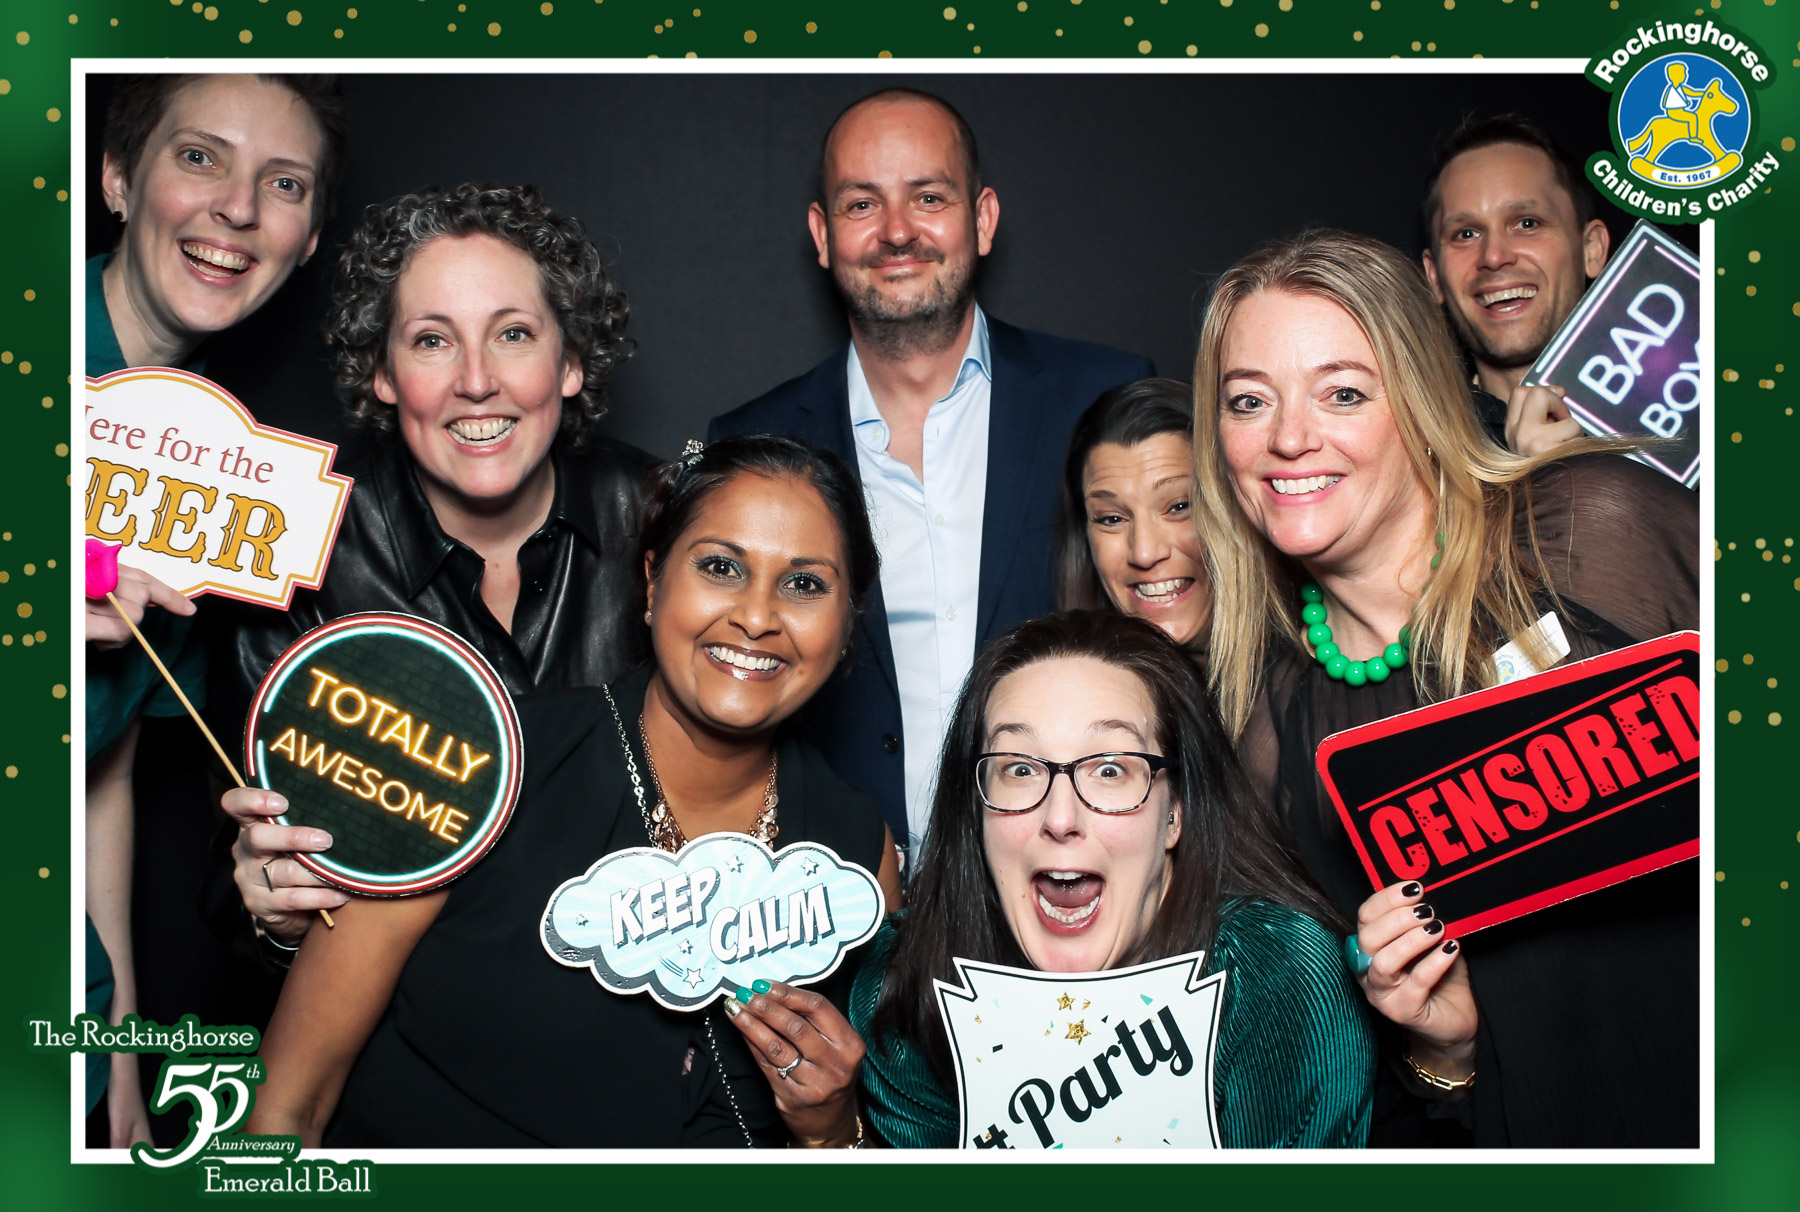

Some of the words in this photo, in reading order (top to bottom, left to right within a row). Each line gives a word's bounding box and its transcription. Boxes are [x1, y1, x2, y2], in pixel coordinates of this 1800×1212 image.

[1578, 283, 1685, 406] BAD
[85, 405, 146, 450] ere
[154, 427, 211, 467] for
[219, 446, 274, 484] the
[85, 457, 289, 580] EER
[309, 667, 491, 784] TOTALLY
[1369, 675, 1700, 881] CENSORED
[270, 727, 470, 845] AWESOME
[610, 866, 721, 948] KEEP
[710, 883, 835, 964] CALM
